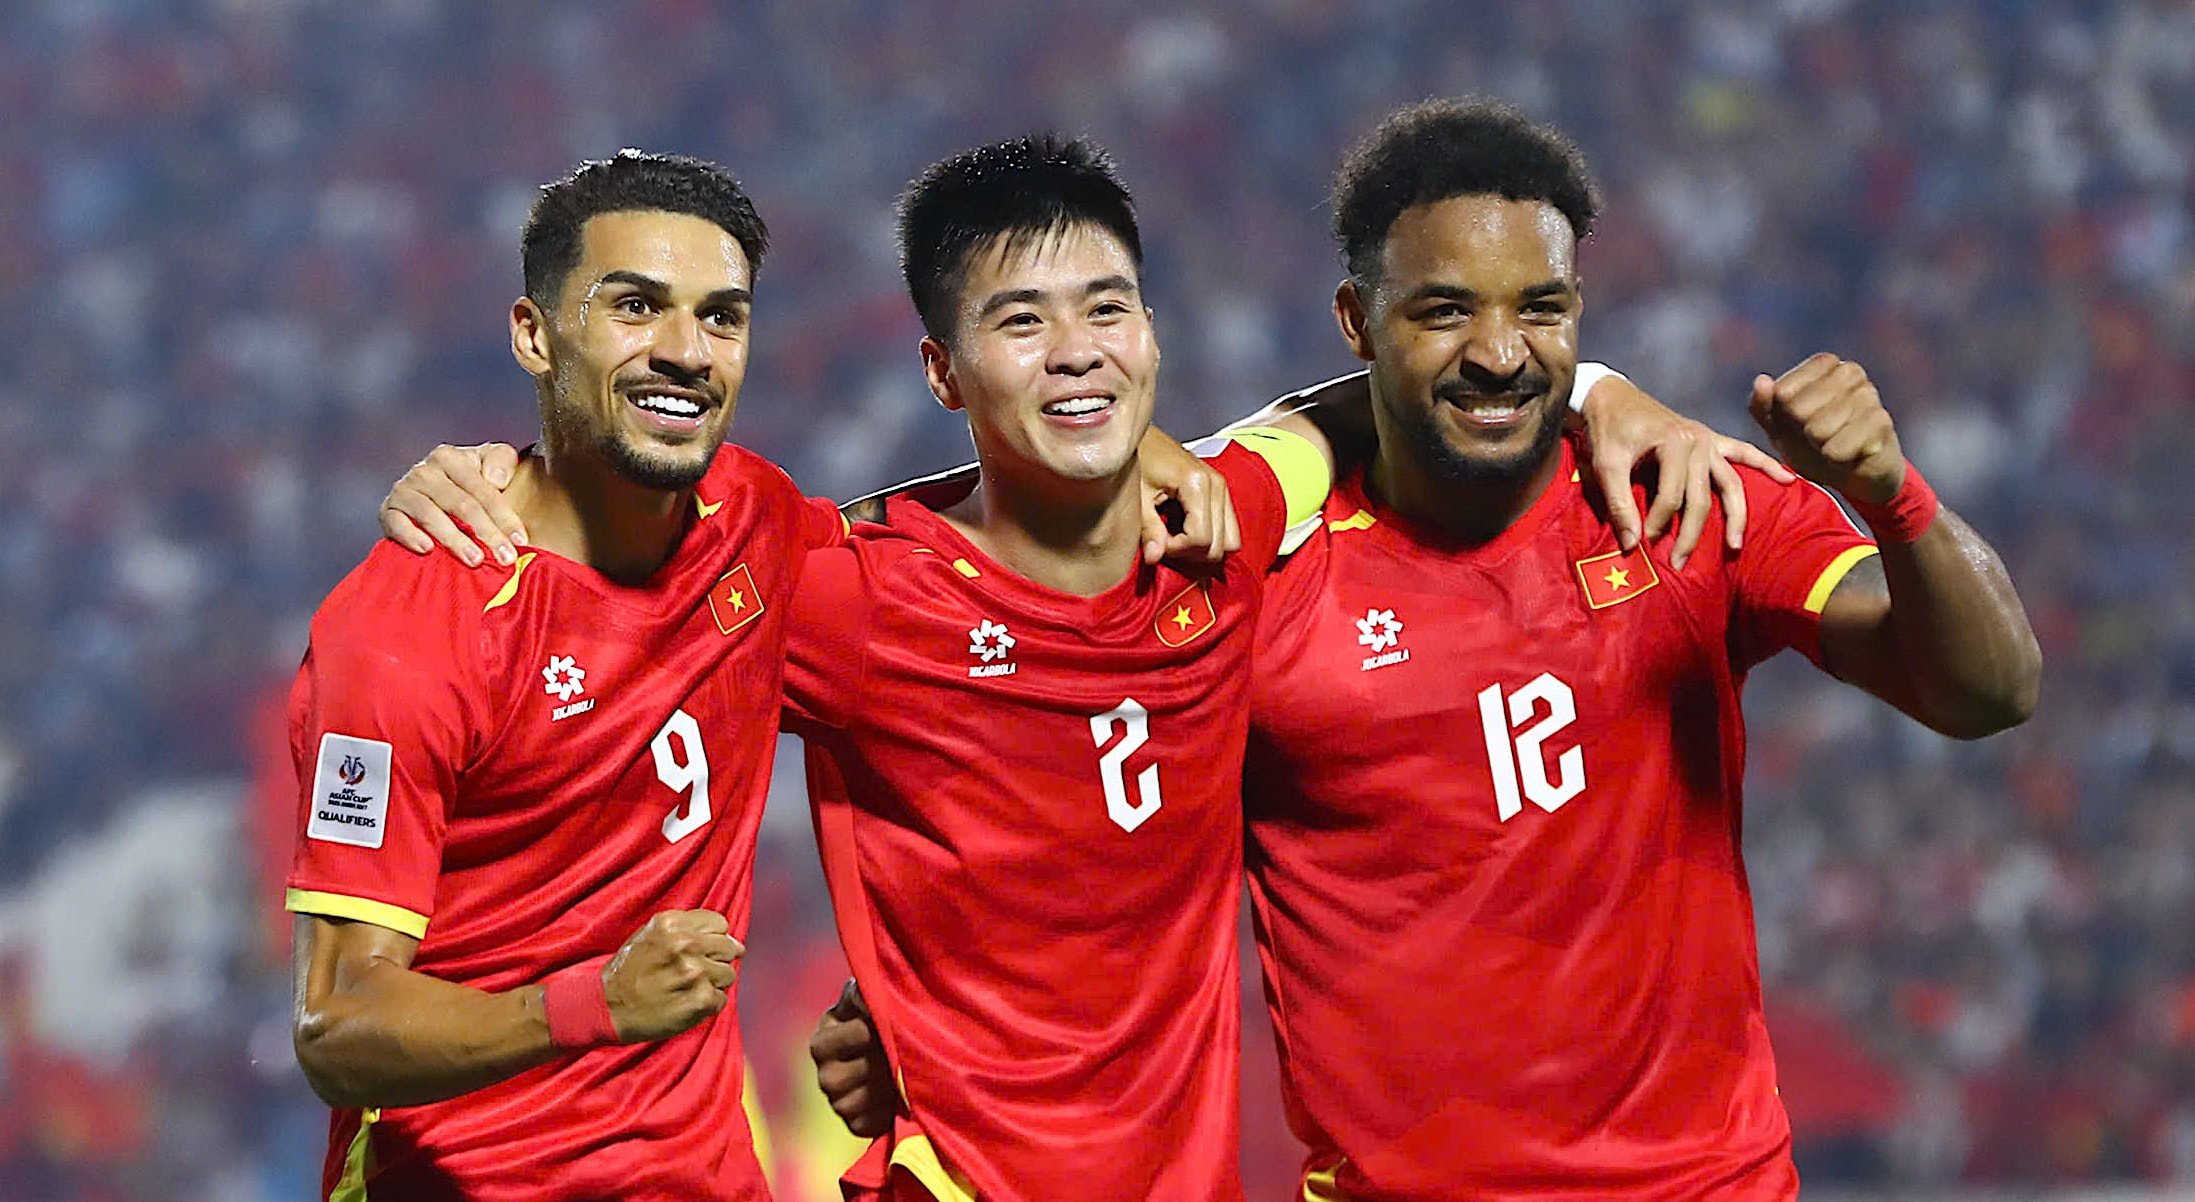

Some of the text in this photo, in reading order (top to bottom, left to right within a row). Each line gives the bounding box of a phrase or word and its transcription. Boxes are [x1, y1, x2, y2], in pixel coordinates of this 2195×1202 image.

[329, 792, 352, 801] ASIAN
[650, 708, 712, 844] 9
[1089, 697, 1162, 833] 2
[1477, 672, 1586, 823] 12
[318, 810, 376, 827] QUALIFIERS
